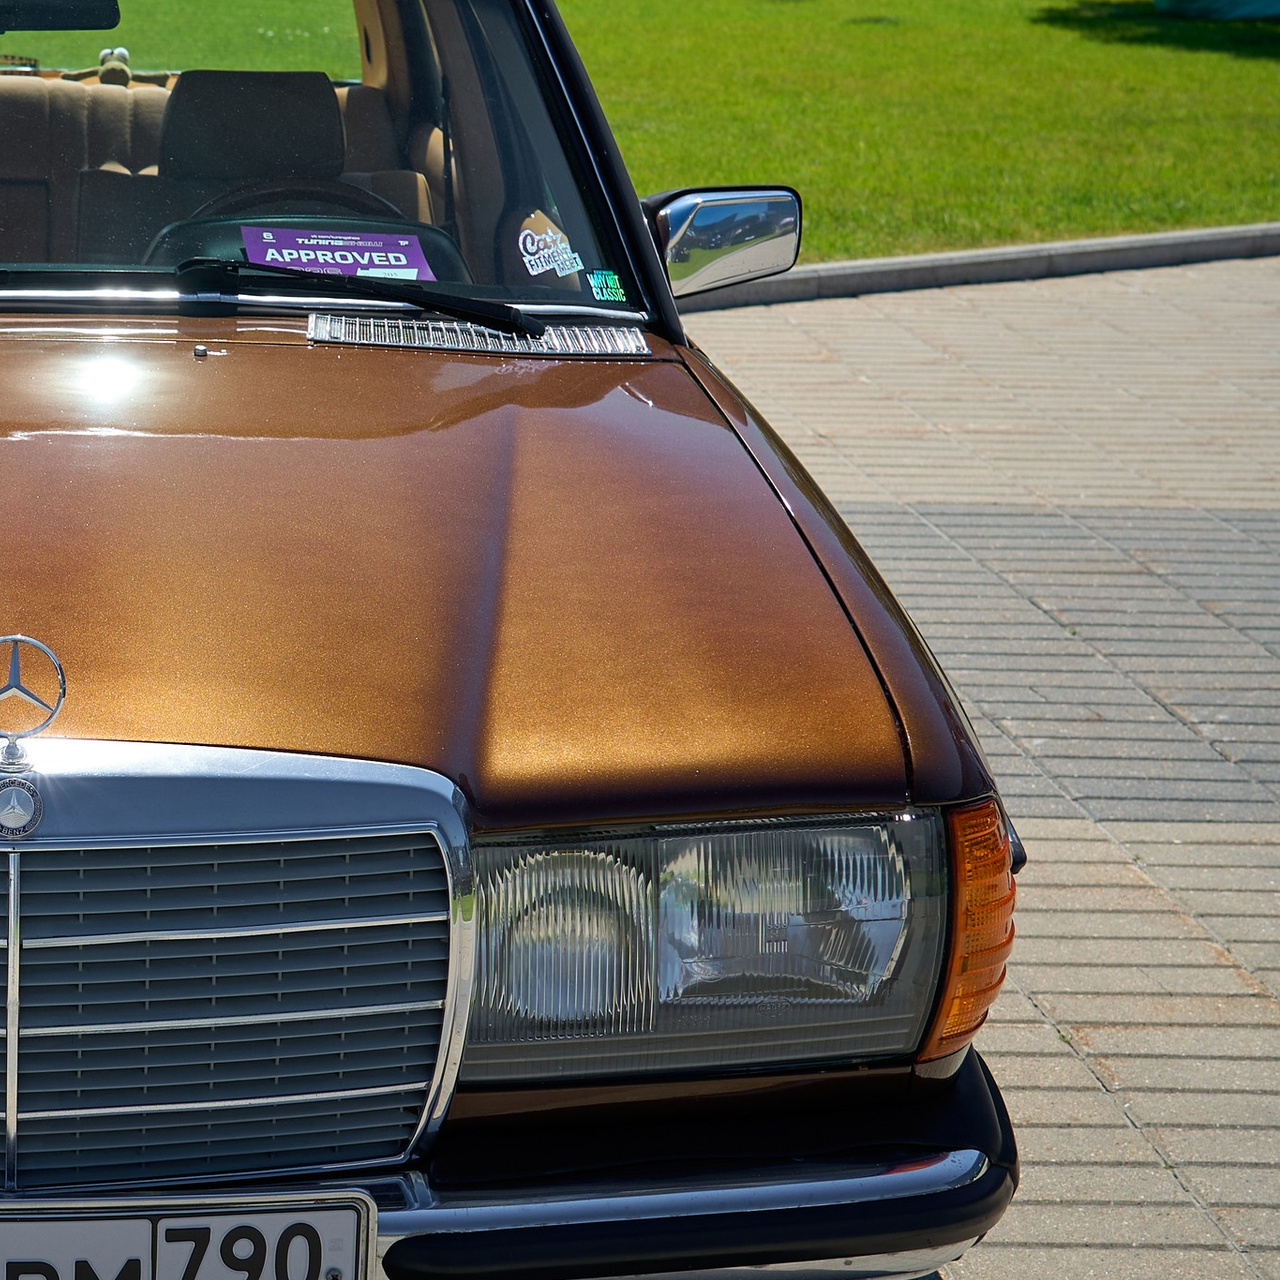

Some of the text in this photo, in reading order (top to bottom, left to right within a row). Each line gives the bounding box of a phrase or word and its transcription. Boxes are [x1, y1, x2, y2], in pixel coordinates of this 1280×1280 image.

[265, 248, 408, 265] APPROVED
[528, 246, 572, 271] FITMENT
[557, 257, 580, 273] MEET
[592, 287, 626, 302] CLASSIC
[2, 827, 25, 836] BENZ
